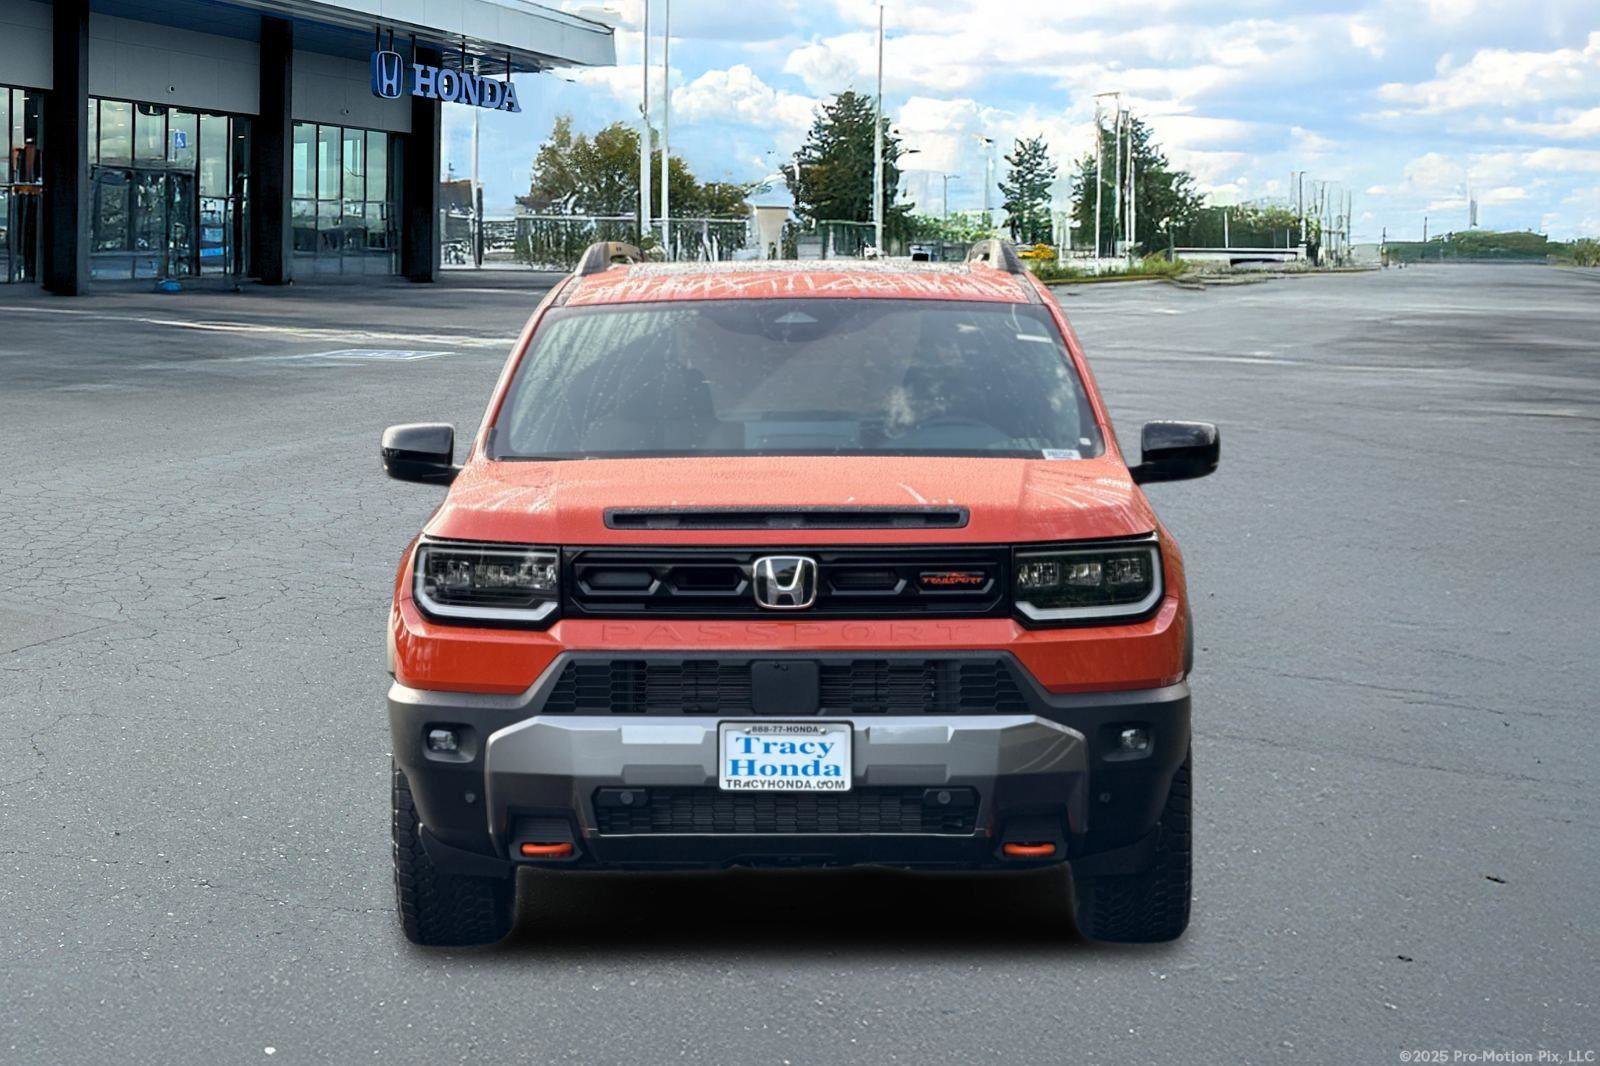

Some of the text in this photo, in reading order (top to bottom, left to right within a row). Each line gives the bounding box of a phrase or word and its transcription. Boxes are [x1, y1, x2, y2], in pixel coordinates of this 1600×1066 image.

[412, 63, 522, 113] HONDA
[600, 622, 972, 643] PASSPORT
[751, 725, 819, 733] 888-77-HONDA
[736, 736, 835, 759] Tracy
[728, 759, 842, 777] Honda
[726, 779, 845, 789] TRACYHONDA.COM
